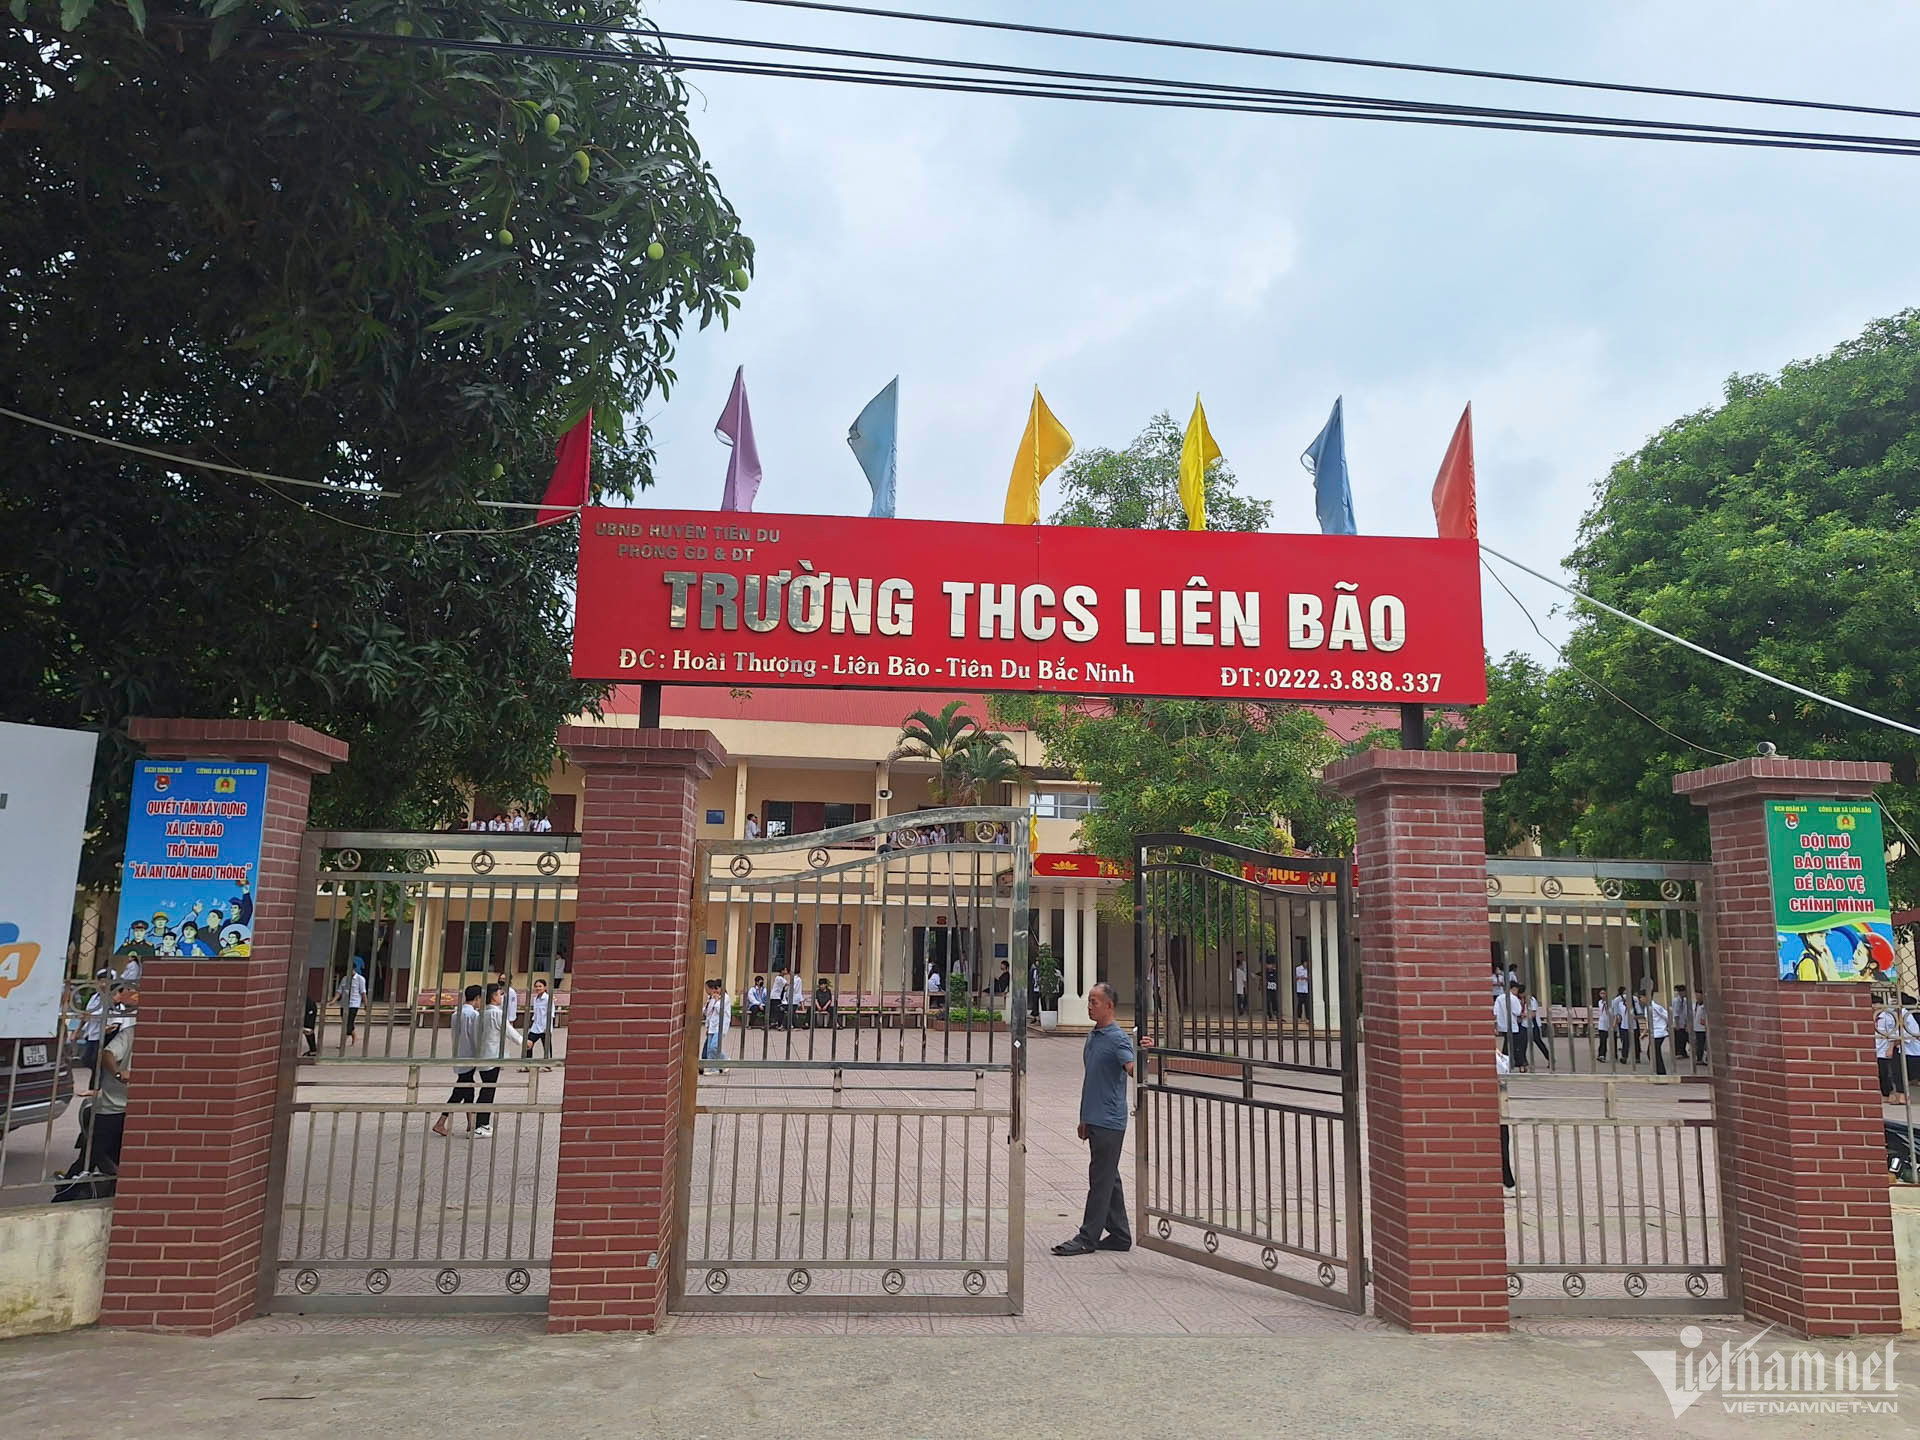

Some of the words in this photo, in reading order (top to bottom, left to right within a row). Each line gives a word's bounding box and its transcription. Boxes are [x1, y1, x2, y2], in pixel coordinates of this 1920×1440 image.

[595, 522, 643, 537] UBND
[713, 524, 751, 541] TIÊN
[757, 528, 781, 543] DU
[684, 546, 708, 560] GD
[714, 547, 726, 561] &
[732, 548, 755, 562] ĐT
[663, 559, 915, 636] TRƯỜNG
[942, 581, 1099, 642] THCS
[1125, 575, 1260, 648] LIÊN
[1288, 580, 1406, 653] BÃO
[619, 648, 666, 669] ĐC:
[672, 650, 727, 671] Hoài
[733, 651, 817, 678] Thượng
[833, 654, 880, 676] Liên
[887, 656, 930, 677] Bão
[945, 657, 993, 679] Tiên
[1000, 659, 1031, 680] Du
[1038, 656, 1078, 681] Bắc
[1085, 662, 1135, 684] Ninh
[147, 797, 177, 816] QUYẾT
[178, 799, 198, 815] TÂM
[200, 798, 218, 815] XÂY
[220, 800, 247, 819] DỰNG
[165, 820, 180, 836] XÃ
[181, 820, 202, 836] LIÊN
[203, 820, 224, 837] BÃO
[167, 840, 186, 857] TRỞ
[187, 841, 219, 858] THÀNH
[1800, 832, 1825, 851] ĐỘI
[1827, 832, 1851, 849] MŨ
[1793, 852, 1823, 869] BẢO
[1825, 851, 1862, 870] HIỂM
[149, 865, 163, 878] AN
[165, 862, 189, 878] TOÀN
[191, 865, 213, 879] GIAO
[1816, 873, 1845, 891] BẢO
[1846, 874, 1865, 894] VỆ
[1789, 895, 1834, 912] CHÍNH
[1836, 896, 1875, 912] MÌNH
